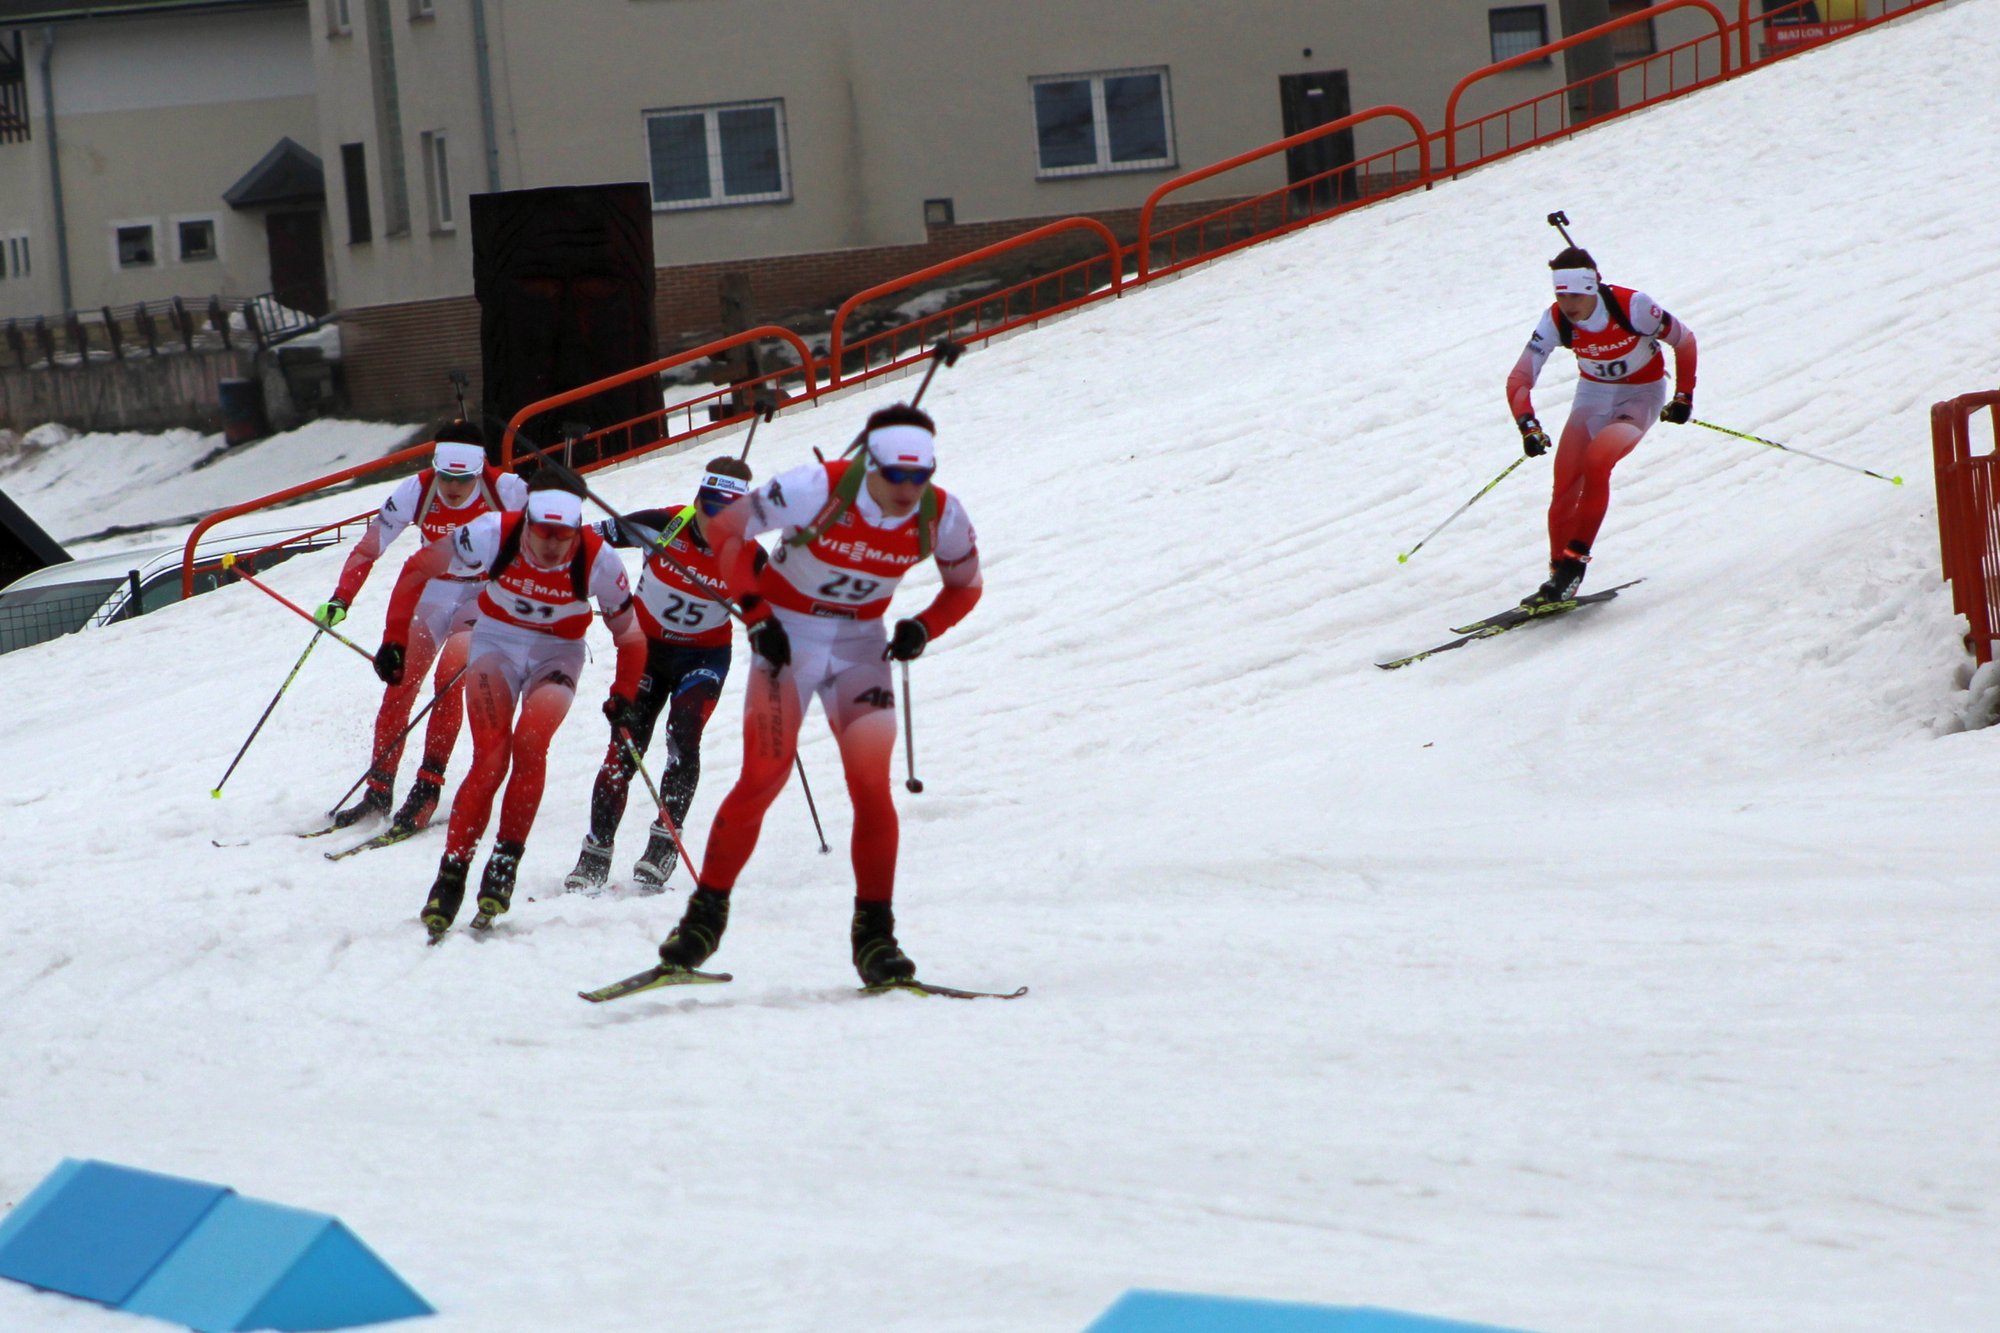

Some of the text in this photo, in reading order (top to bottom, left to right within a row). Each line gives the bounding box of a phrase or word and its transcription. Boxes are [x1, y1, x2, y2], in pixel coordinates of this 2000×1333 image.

[1590, 361, 1628, 378] 30
[818, 570, 880, 600] 29
[661, 592, 708, 626] 25
